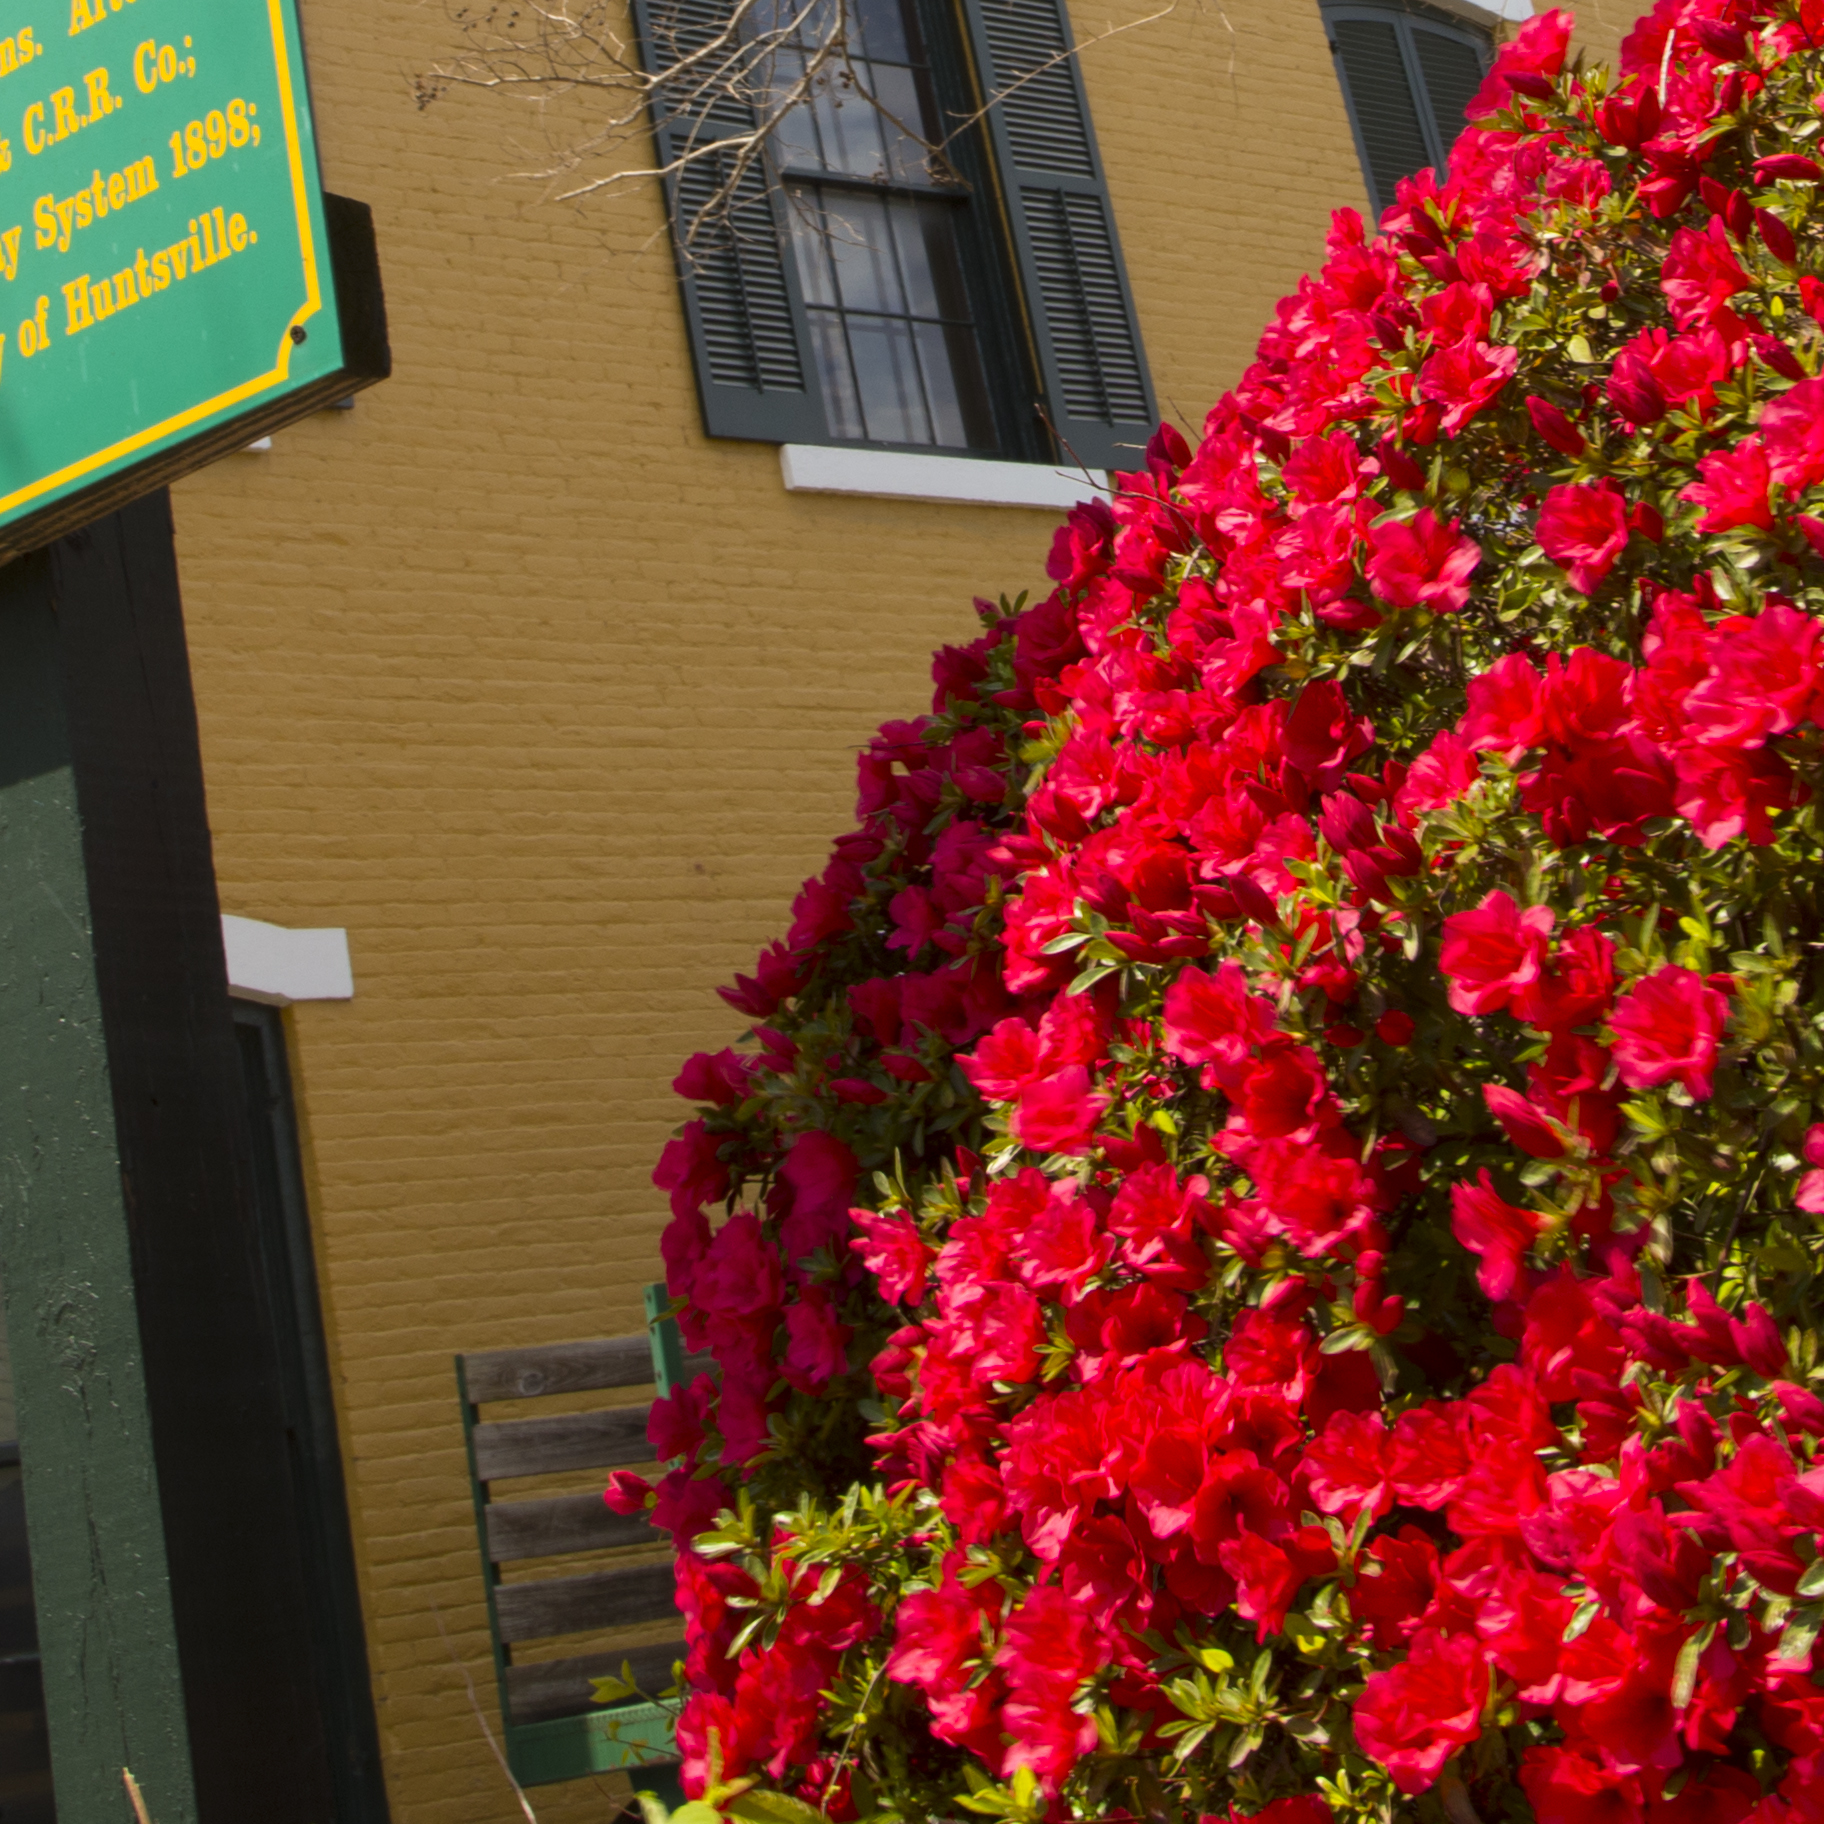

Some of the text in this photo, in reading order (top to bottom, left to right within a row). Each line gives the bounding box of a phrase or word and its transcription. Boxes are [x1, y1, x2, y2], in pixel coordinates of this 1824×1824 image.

[21, 65, 124, 157] C.R.R.
[132, 34, 198, 95] Co.;
[31, 154, 161, 254] System
[167, 96, 262, 180] 1898;
[16, 294, 52, 359] of
[60, 204, 259, 337] Huntsville.
